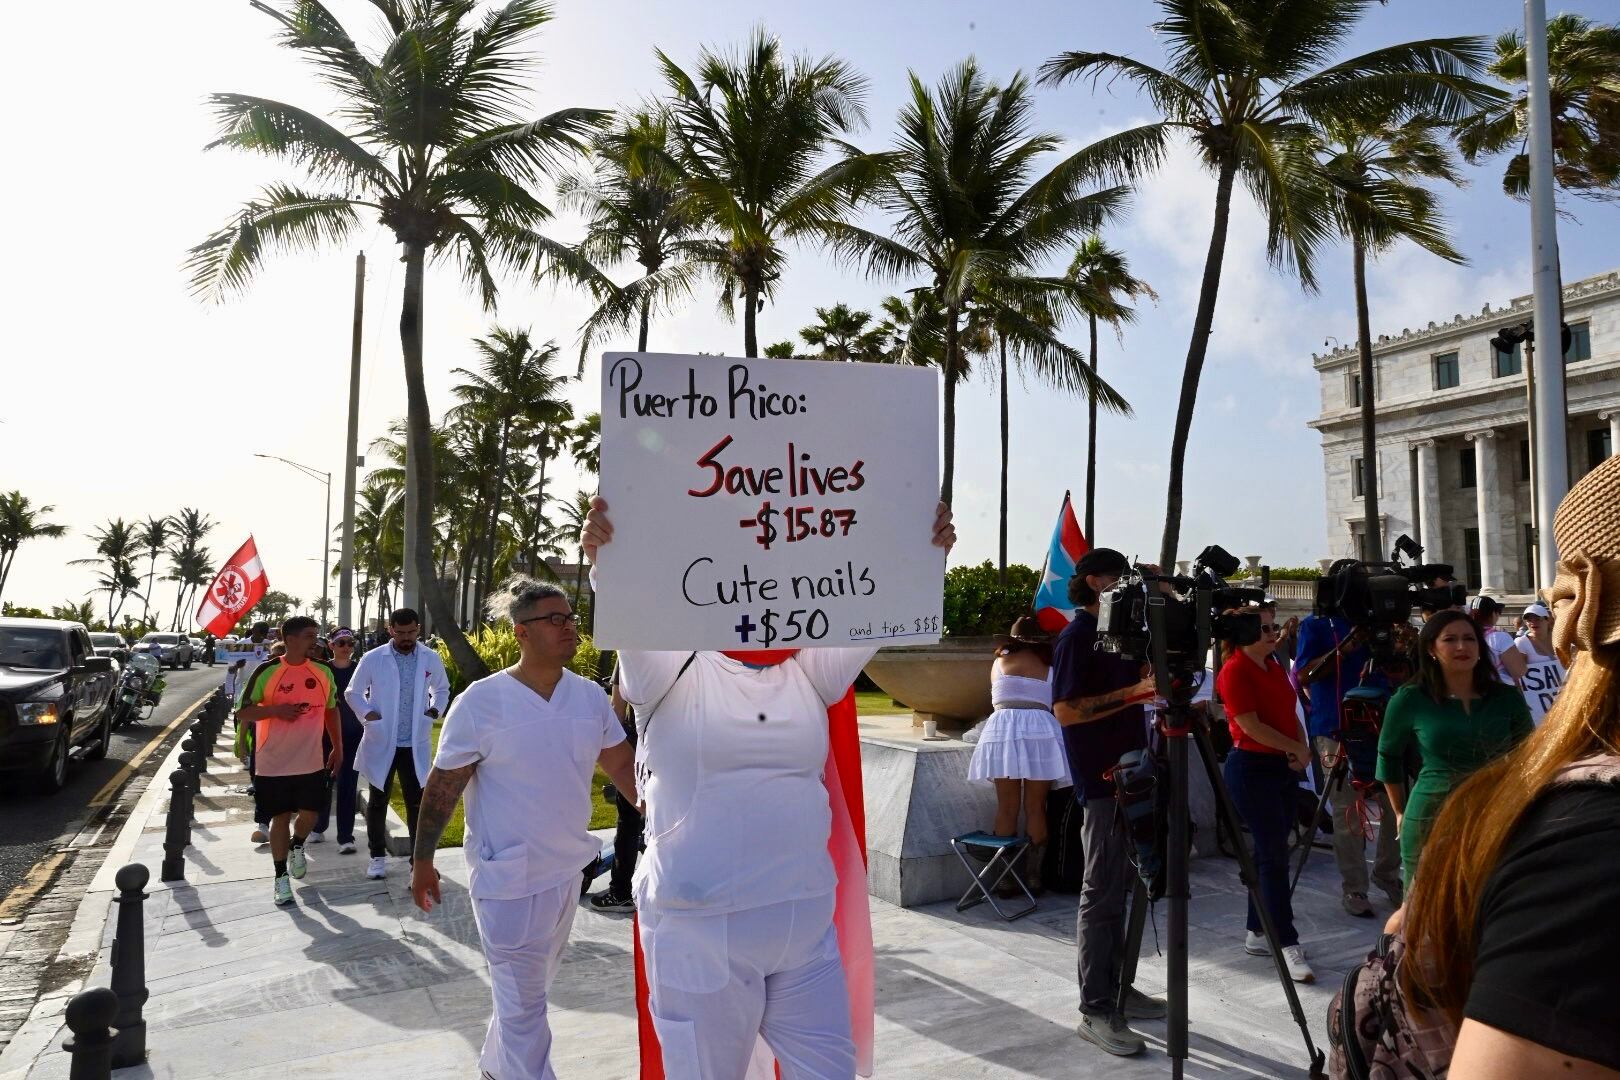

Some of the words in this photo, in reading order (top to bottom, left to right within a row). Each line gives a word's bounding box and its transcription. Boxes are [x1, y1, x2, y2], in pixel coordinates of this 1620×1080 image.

[610, 357, 718, 419] Puerto
[728, 364, 808, 420] Rico:
[688, 434, 784, 497] Save
[788, 442, 865, 497] lives
[682, 556, 778, 606] Cute
[791, 561, 876, 600] nails
[735, 608, 829, 648] +$50
[849, 622, 872, 637] and
[882, 621, 905, 637] tips
[914, 615, 939, 633] $$$
